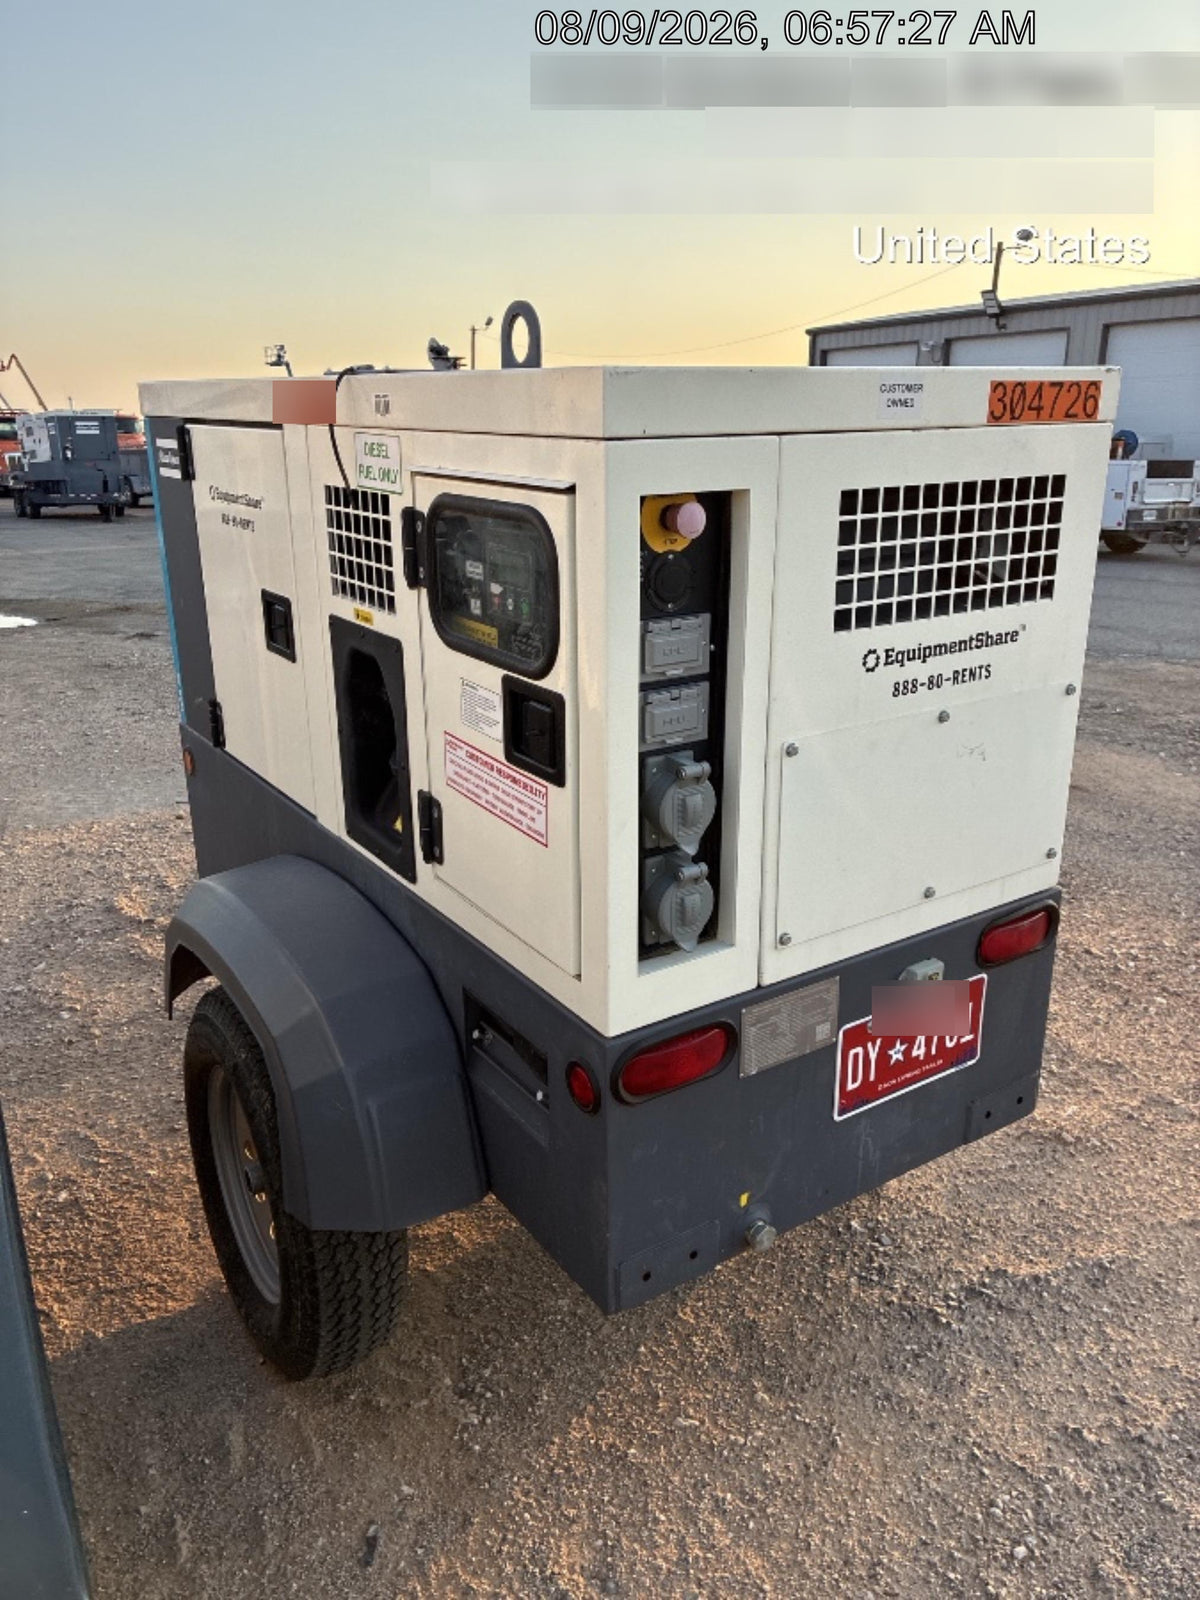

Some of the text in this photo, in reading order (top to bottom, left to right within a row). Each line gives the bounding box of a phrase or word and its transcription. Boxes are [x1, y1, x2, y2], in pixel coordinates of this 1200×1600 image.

[990, 380, 1100, 421] 304726
[363, 441, 391, 459] DIESEL
[358, 463, 399, 485] FUEL ONLY
[883, 629, 1020, 668] EquipmentShare
[892, 663, 992, 698] 888-80-RENTS
[846, 1037, 883, 1092] DY
